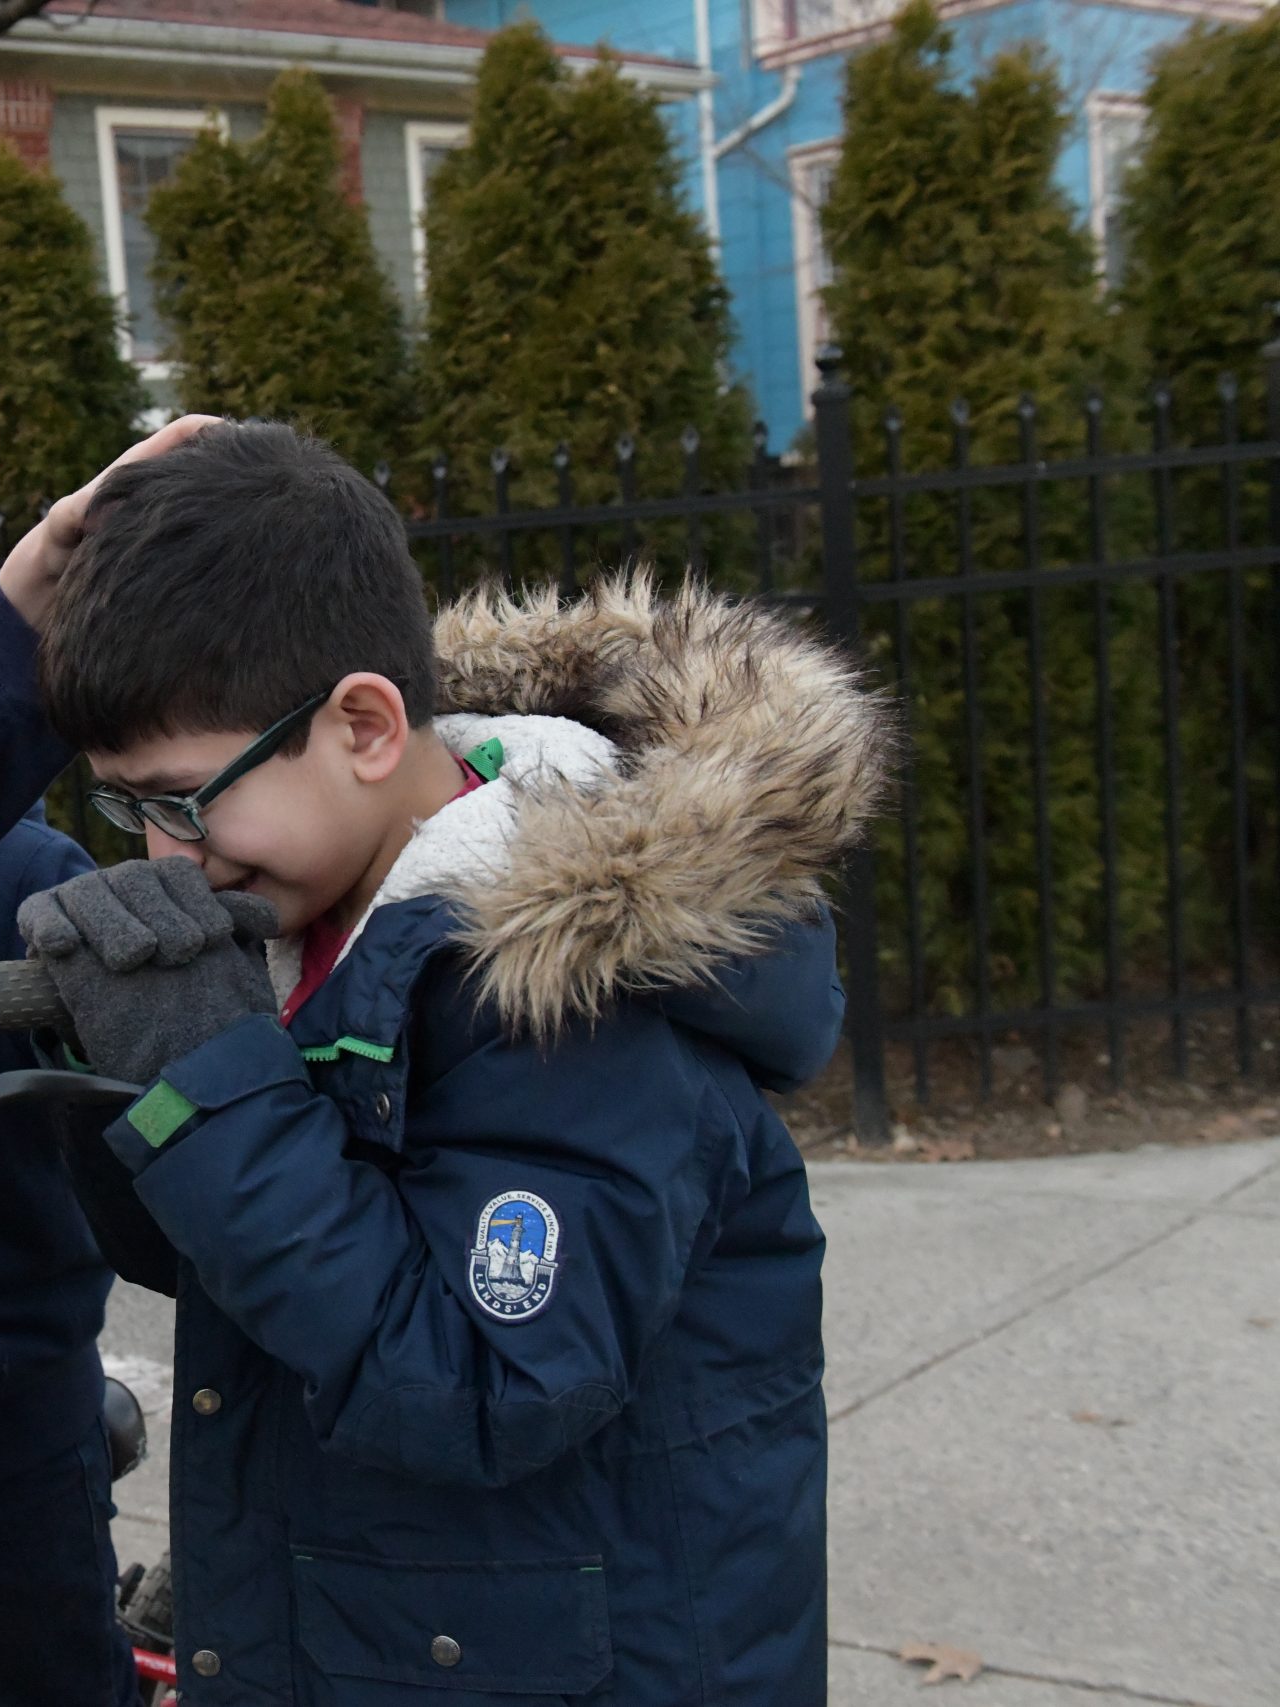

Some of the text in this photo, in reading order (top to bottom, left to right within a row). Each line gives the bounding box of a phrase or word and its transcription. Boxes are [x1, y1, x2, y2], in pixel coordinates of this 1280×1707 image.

[517, 1193, 548, 1211] SERVICE
[545, 1213, 556, 1238] SINCE
[475, 1273, 547, 1313] LANDS' END
